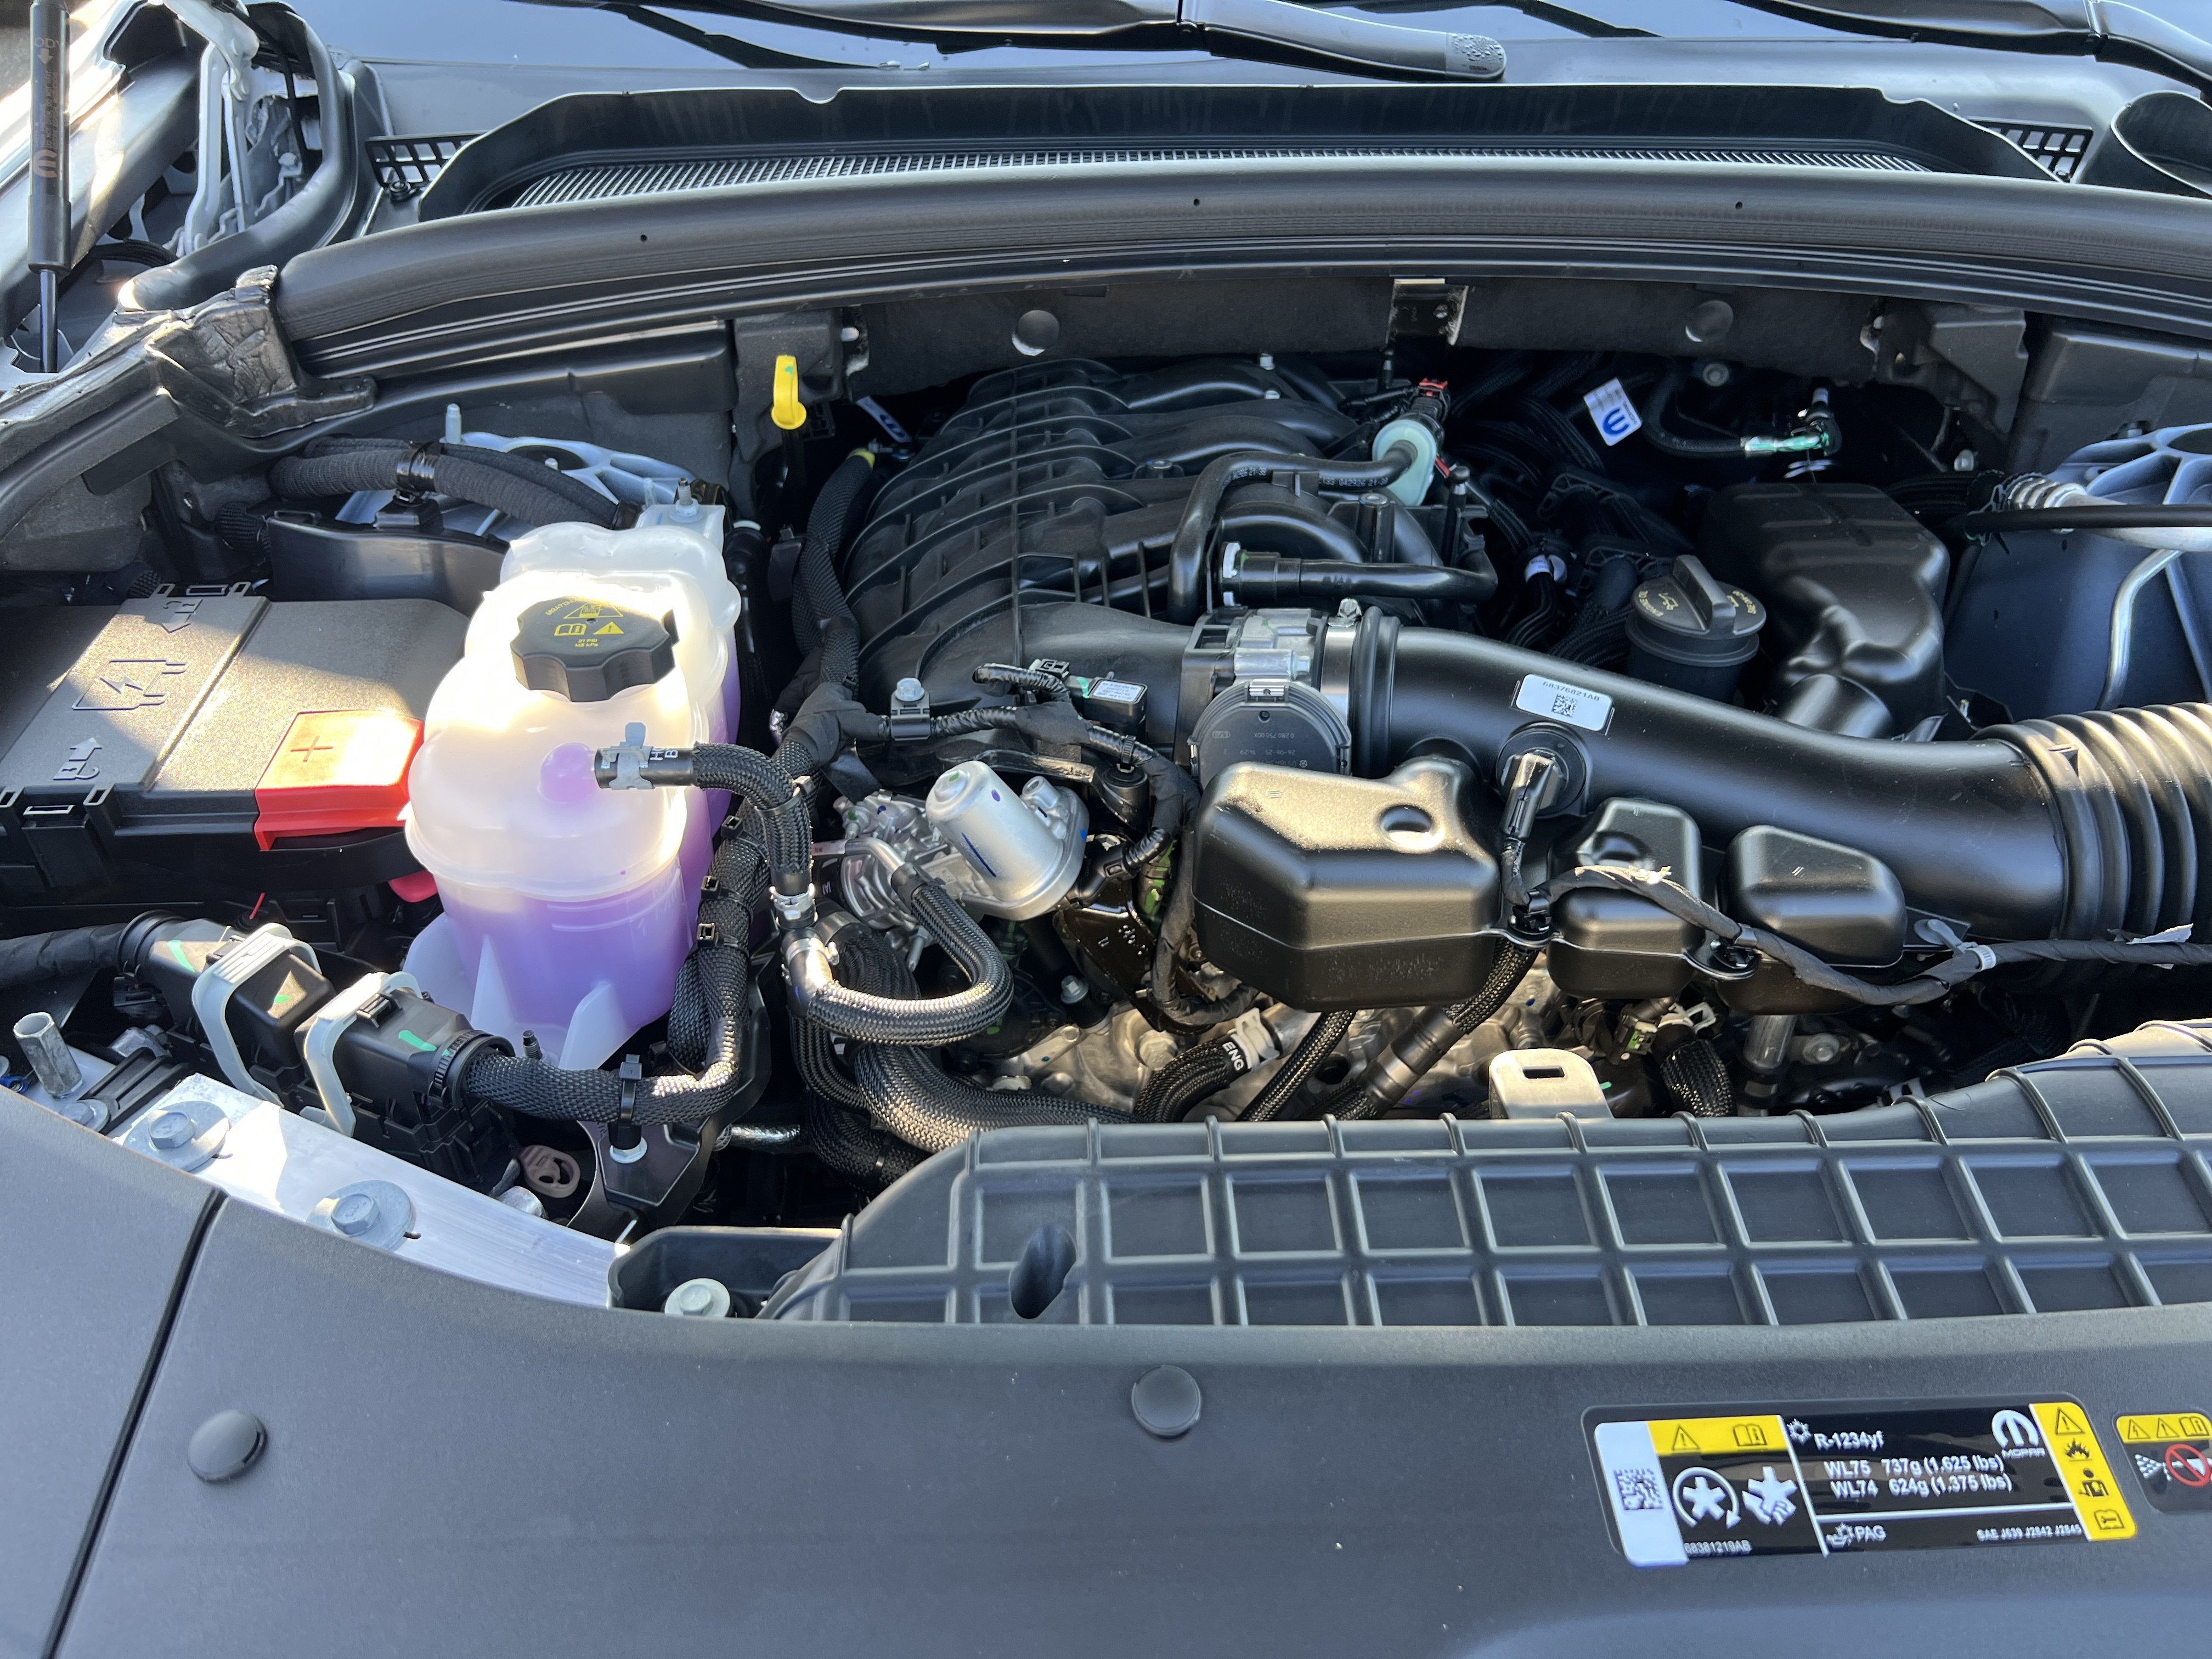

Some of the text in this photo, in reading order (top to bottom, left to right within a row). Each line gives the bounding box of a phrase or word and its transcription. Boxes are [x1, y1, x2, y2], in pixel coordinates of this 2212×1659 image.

[1222, 1041, 1244, 1071] ENG
[1814, 1430, 1884, 1452] R-1234yf
[2001, 1447, 2046, 1459] MOPAR
[1824, 1453, 2005, 1480] WL75 737g (1.625 lbs)
[1830, 1472, 2013, 1499] WL74 624g (1.375 lbs)
[1854, 1525, 1887, 1542] PAG
[1976, 1527, 1999, 1542] SAE
